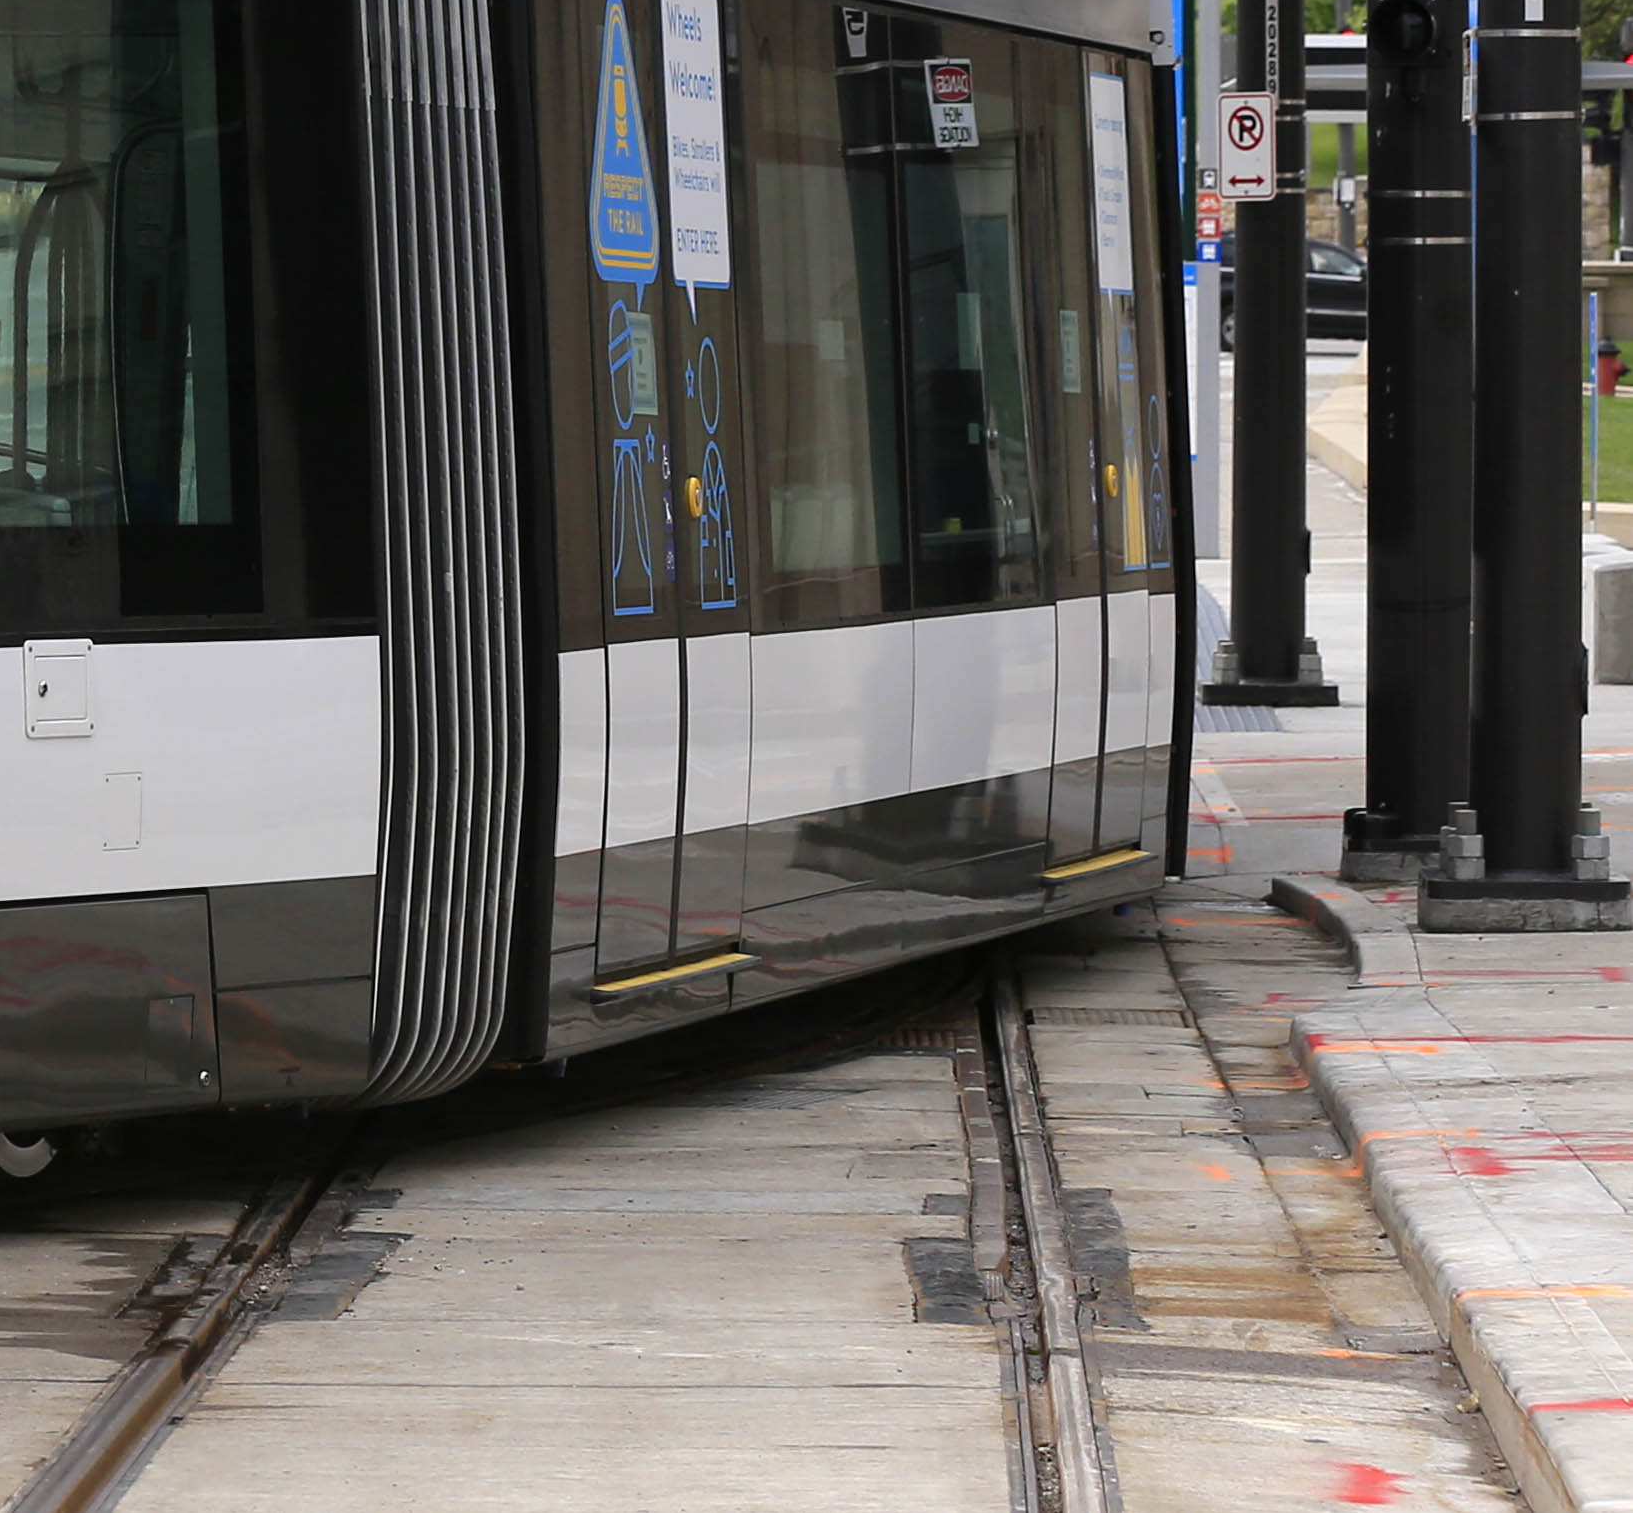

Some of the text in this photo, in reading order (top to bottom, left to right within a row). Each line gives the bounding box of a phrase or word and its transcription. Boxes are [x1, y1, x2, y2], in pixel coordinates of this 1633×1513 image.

[666, 1, 703, 42] Wheels
[669, 60, 717, 102] Welcome!
[606, 208, 624, 233] THE
[677, 227, 699, 253] ENTER
